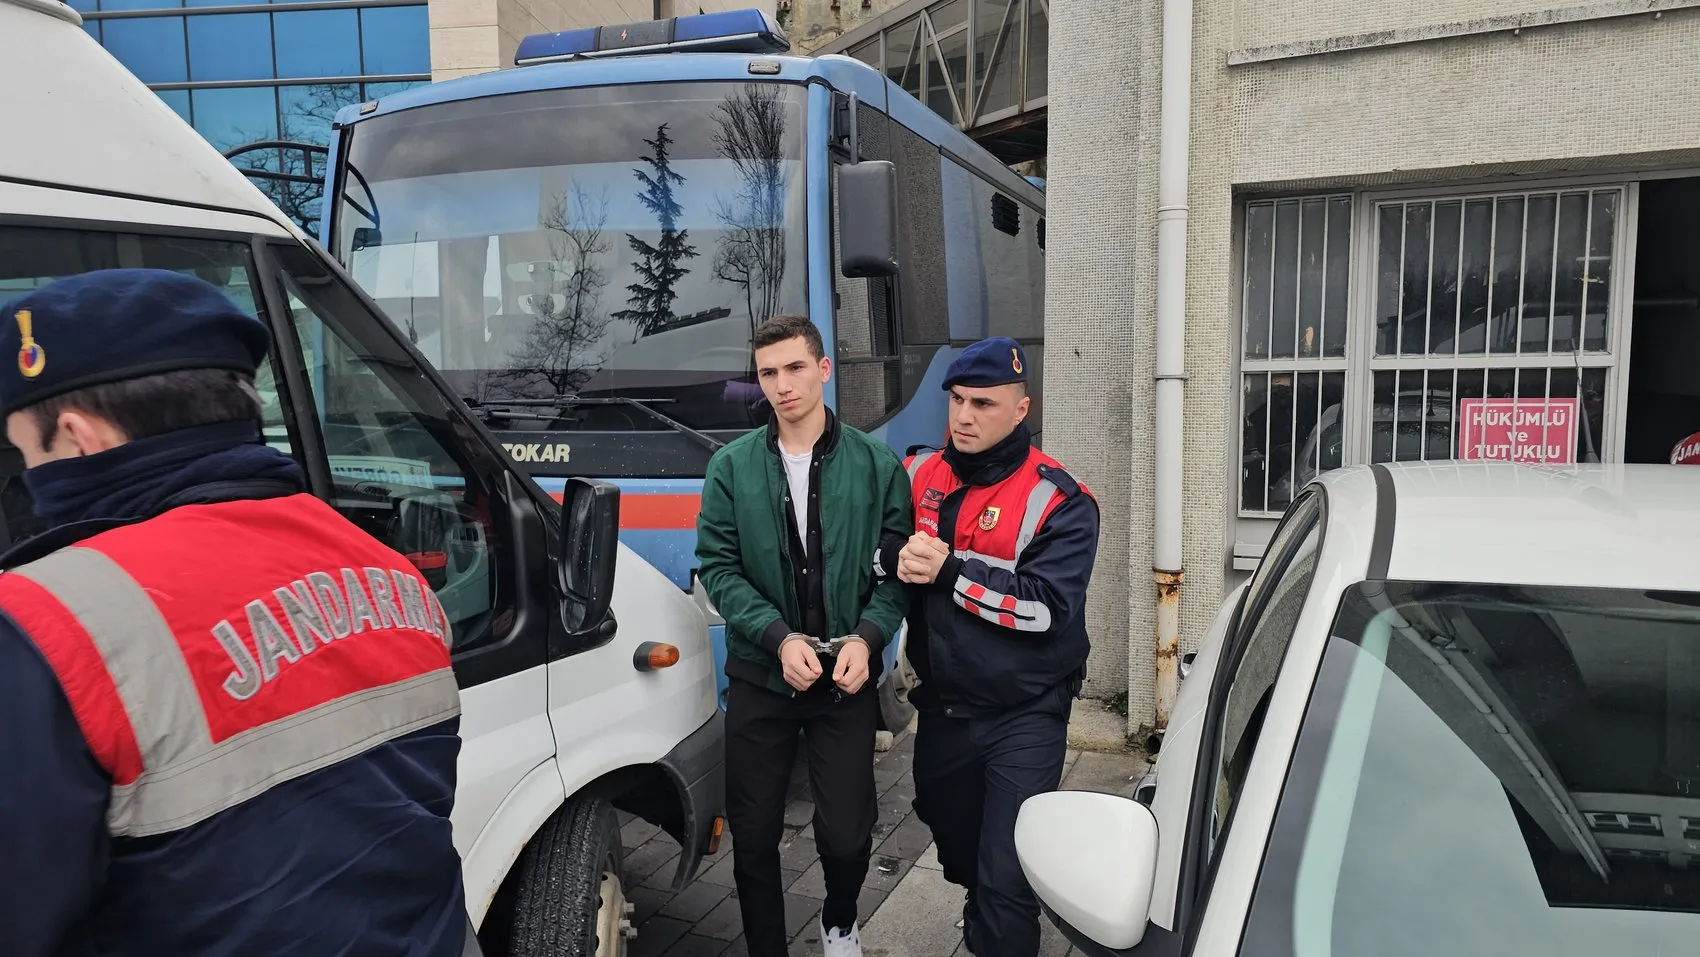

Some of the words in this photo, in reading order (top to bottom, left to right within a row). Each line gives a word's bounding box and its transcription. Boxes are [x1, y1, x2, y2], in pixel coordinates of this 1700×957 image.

[1473, 409, 1566, 426] HÜKÜMLÜ
[1507, 431, 1528, 442] ve
[1475, 445, 1560, 459] TUTUKLU
[210, 567, 446, 701] JANDARMA
